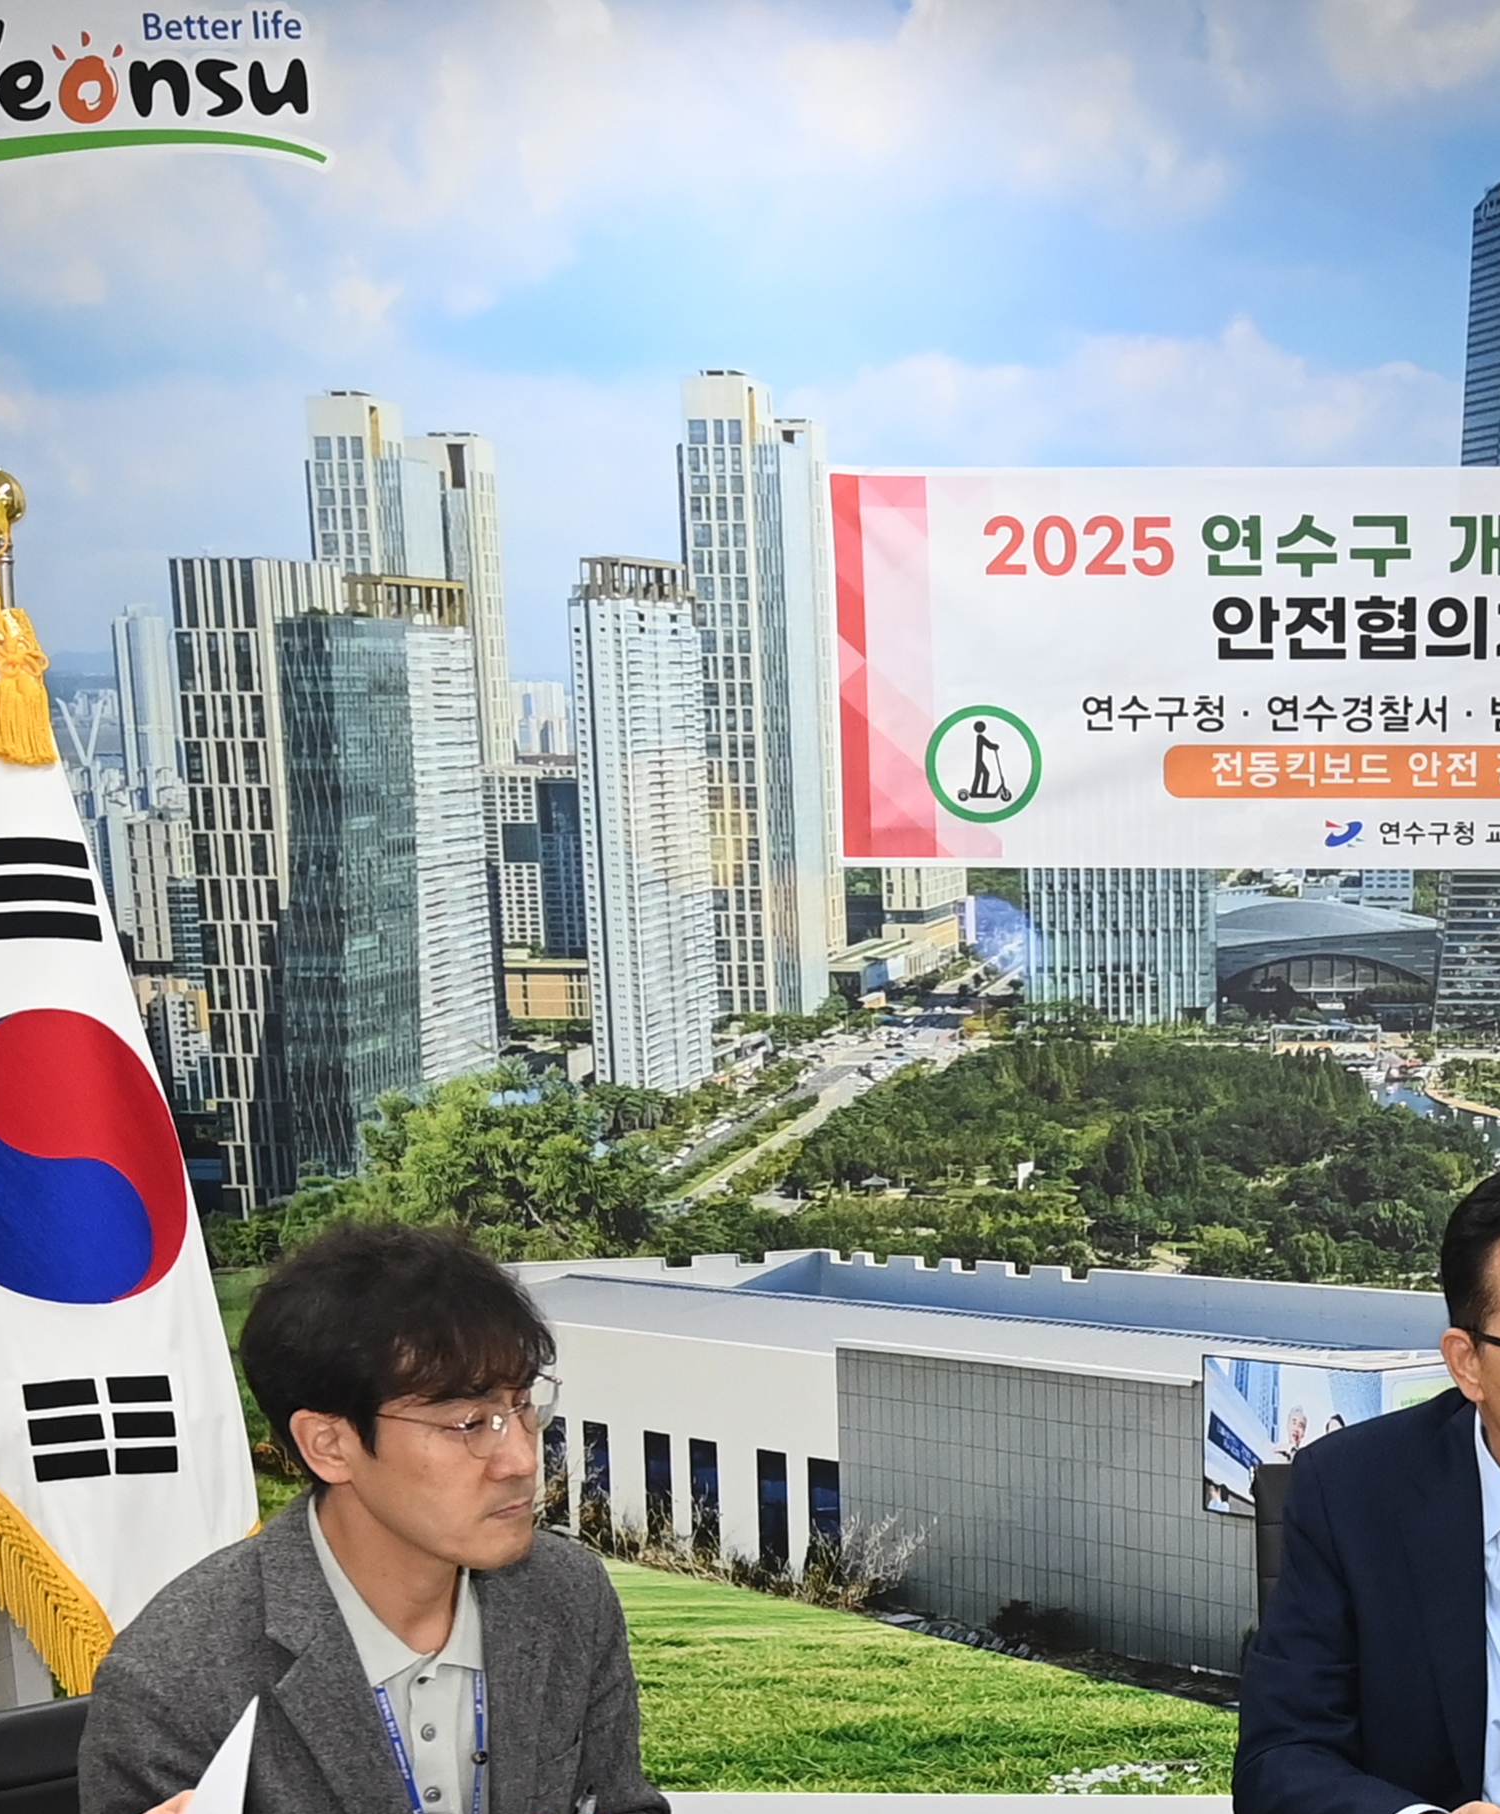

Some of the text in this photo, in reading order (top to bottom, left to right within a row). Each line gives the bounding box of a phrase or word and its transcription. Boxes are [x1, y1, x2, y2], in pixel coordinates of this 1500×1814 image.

[141, 9, 302, 42] Better life
[984, 515, 1174, 576] 2025
[1202, 514, 1411, 578] 연수구
[1082, 695, 1224, 733] 연수구청
[1267, 695, 1447, 733] 연수경찰서
[1212, 752, 1391, 787] 전동킥보드
[1409, 752, 1476, 786] 안전
[1380, 821, 1474, 846] 연수구청
